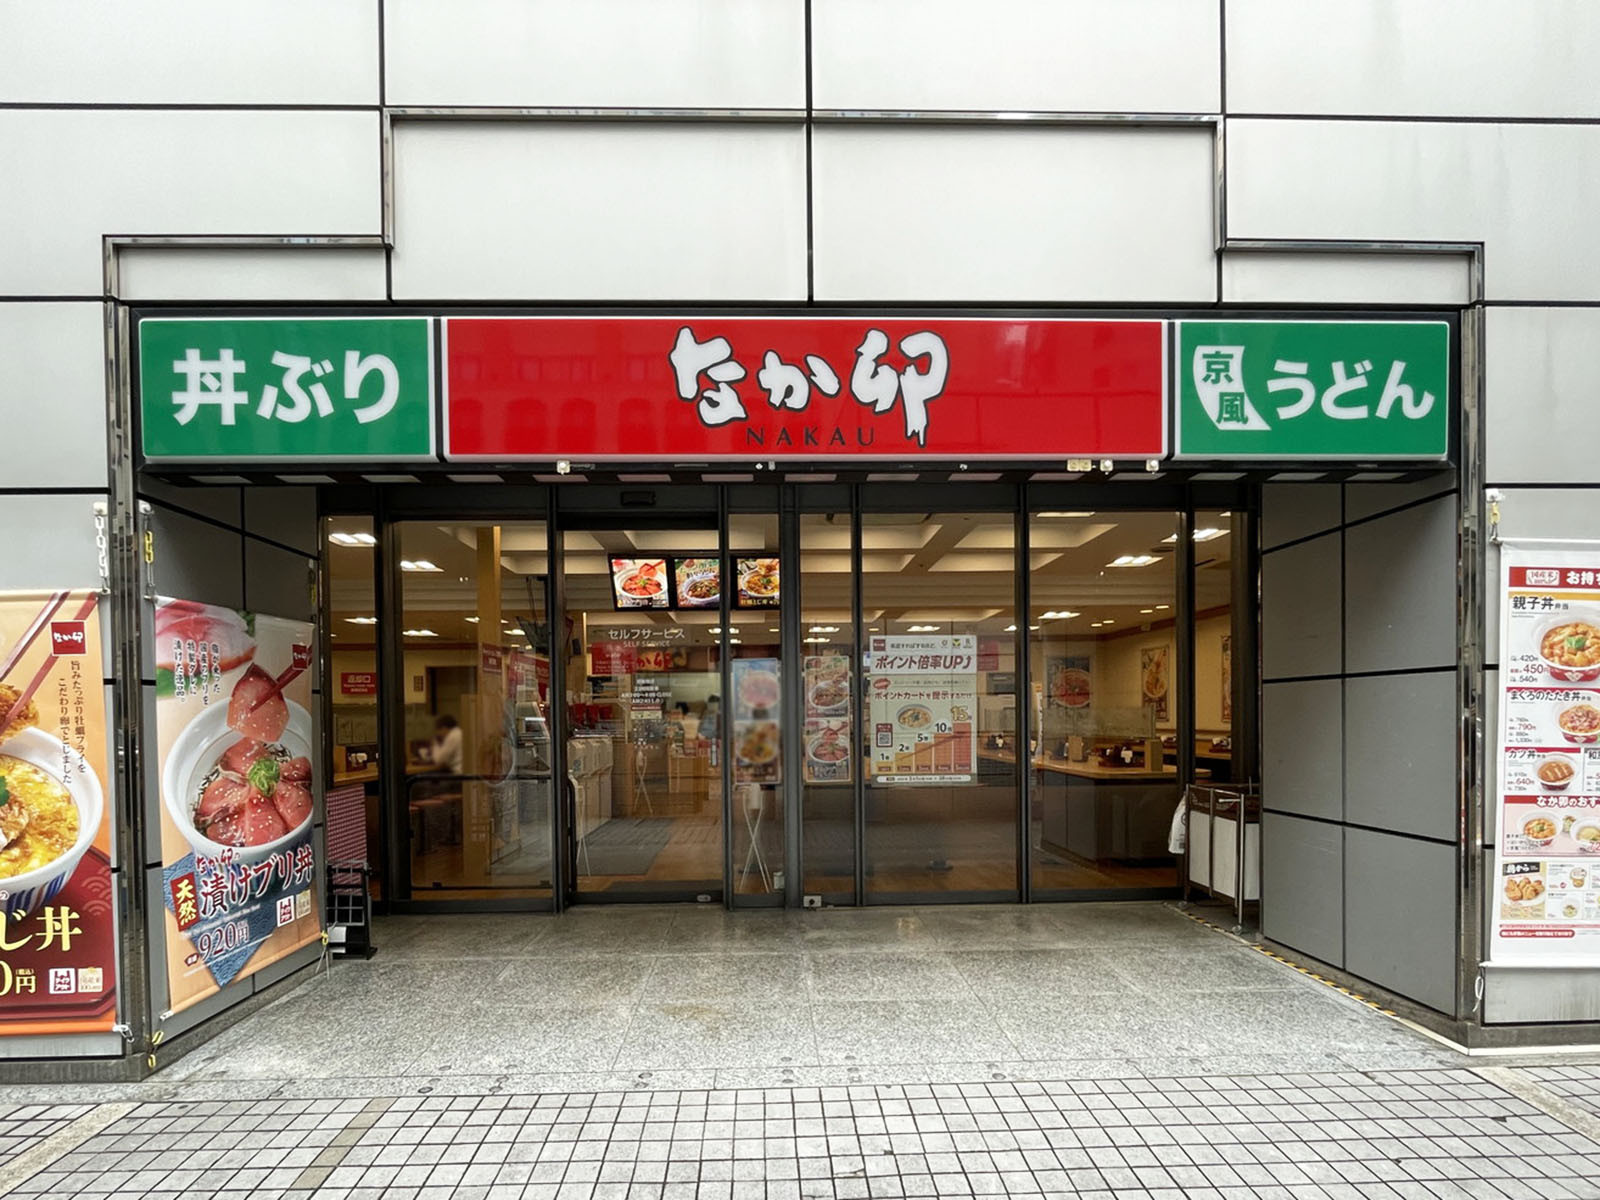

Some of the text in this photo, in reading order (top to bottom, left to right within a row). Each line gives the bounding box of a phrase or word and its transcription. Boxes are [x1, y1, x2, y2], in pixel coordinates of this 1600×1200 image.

[171, 348, 400, 426] 丼ぶり
[668, 325, 950, 449] なか卯
[1266, 359, 1436, 421] うどん
[745, 427, 876, 447] NAKAU
[608, 629, 686, 640] セルフサービス
[176, 879, 198, 926] 天然
[200, 845, 313, 918] 漬けブリ丼
